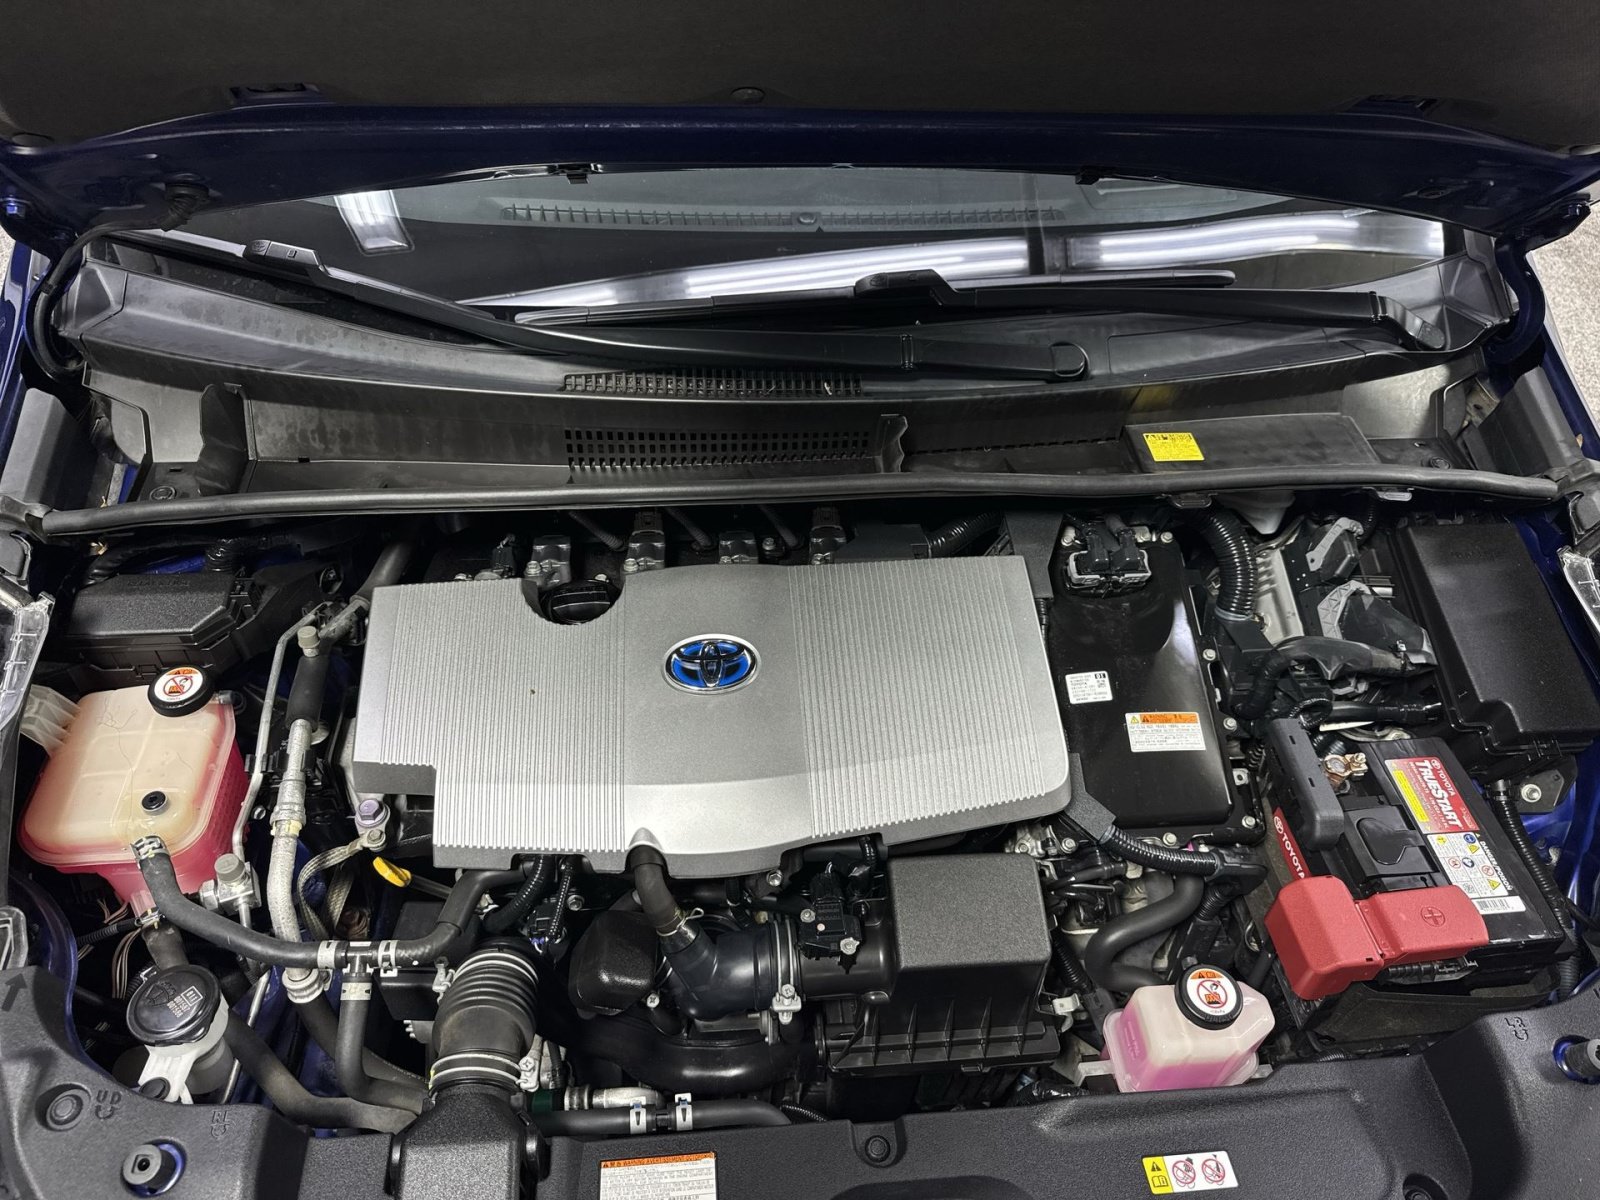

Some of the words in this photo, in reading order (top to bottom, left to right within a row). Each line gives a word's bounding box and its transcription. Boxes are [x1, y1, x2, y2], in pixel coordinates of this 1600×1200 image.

[1415, 759, 1463, 828] TRUESTART
[1437, 768, 1455, 796] TOYOTA
[97, 1090, 121, 1104] UD
